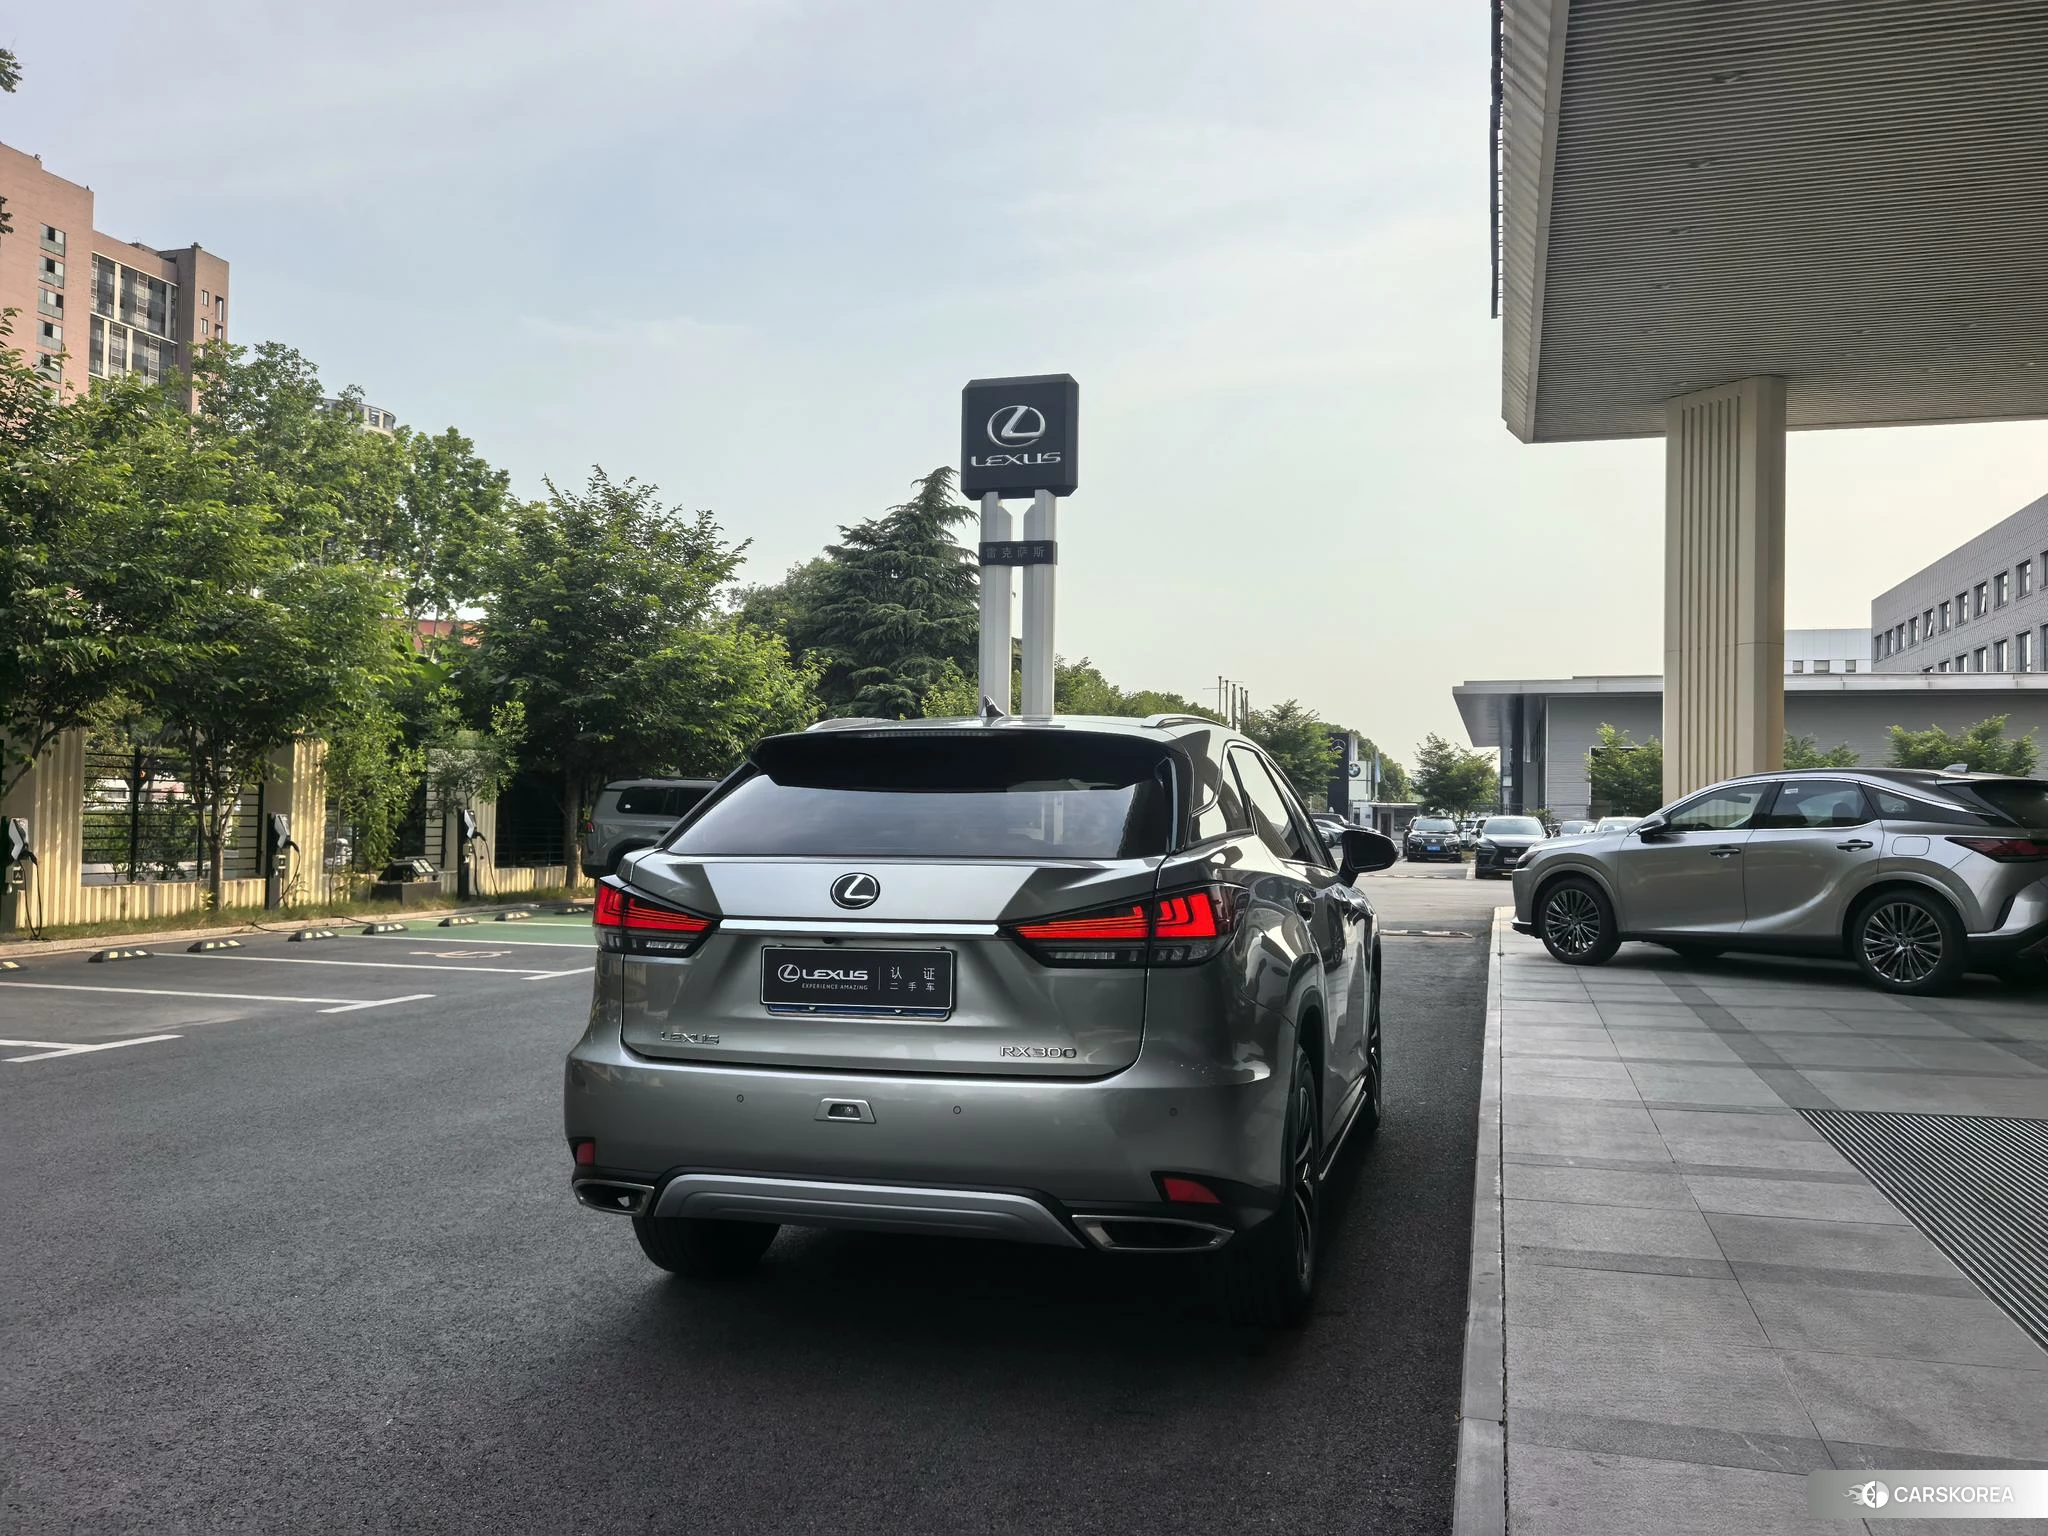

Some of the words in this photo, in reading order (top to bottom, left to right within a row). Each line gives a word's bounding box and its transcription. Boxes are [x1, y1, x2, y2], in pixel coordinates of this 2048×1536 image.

[971, 452, 1061, 467] LEXUS
[986, 546, 1046, 559] 雷克萨斯
[802, 968, 868, 981] LEXUS
[890, 966, 935, 980] 认证
[890, 981, 935, 992] 二手车
[660, 1031, 720, 1045] LEXUS
